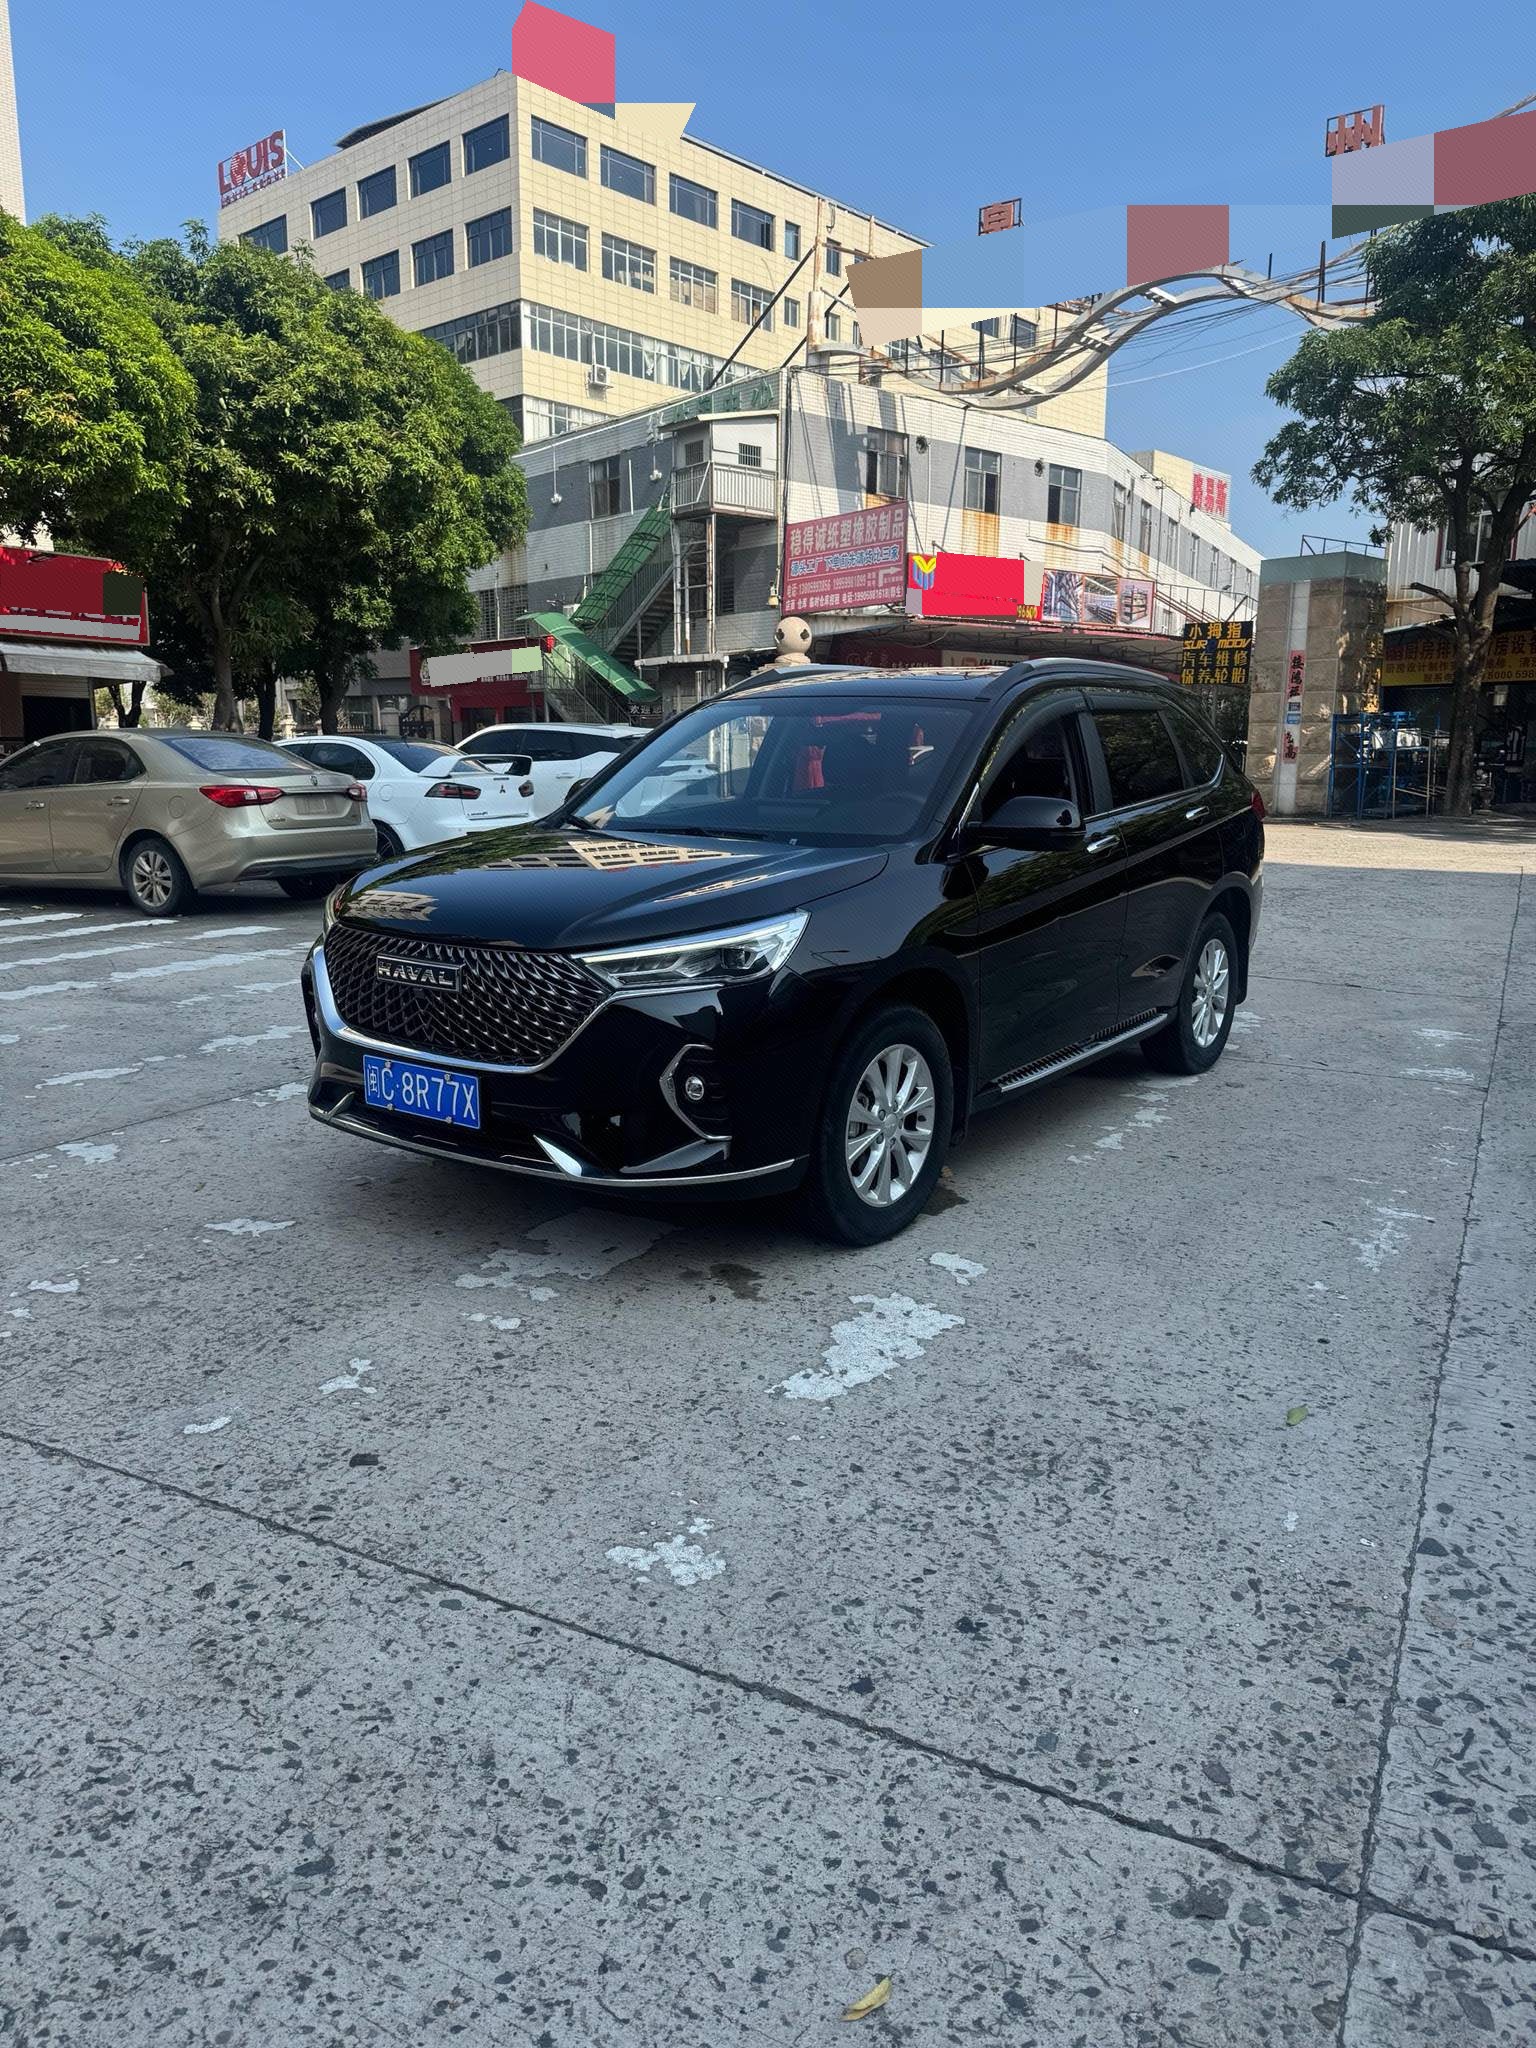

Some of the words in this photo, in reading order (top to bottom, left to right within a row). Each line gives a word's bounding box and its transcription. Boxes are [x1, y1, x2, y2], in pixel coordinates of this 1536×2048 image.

[1189, 622, 1242, 639] 小拇指
[1182, 650, 1248, 667] 汽车维修
[1181, 667, 1246, 684] 保养轮胎
[378, 961, 453, 986] HAVAL
